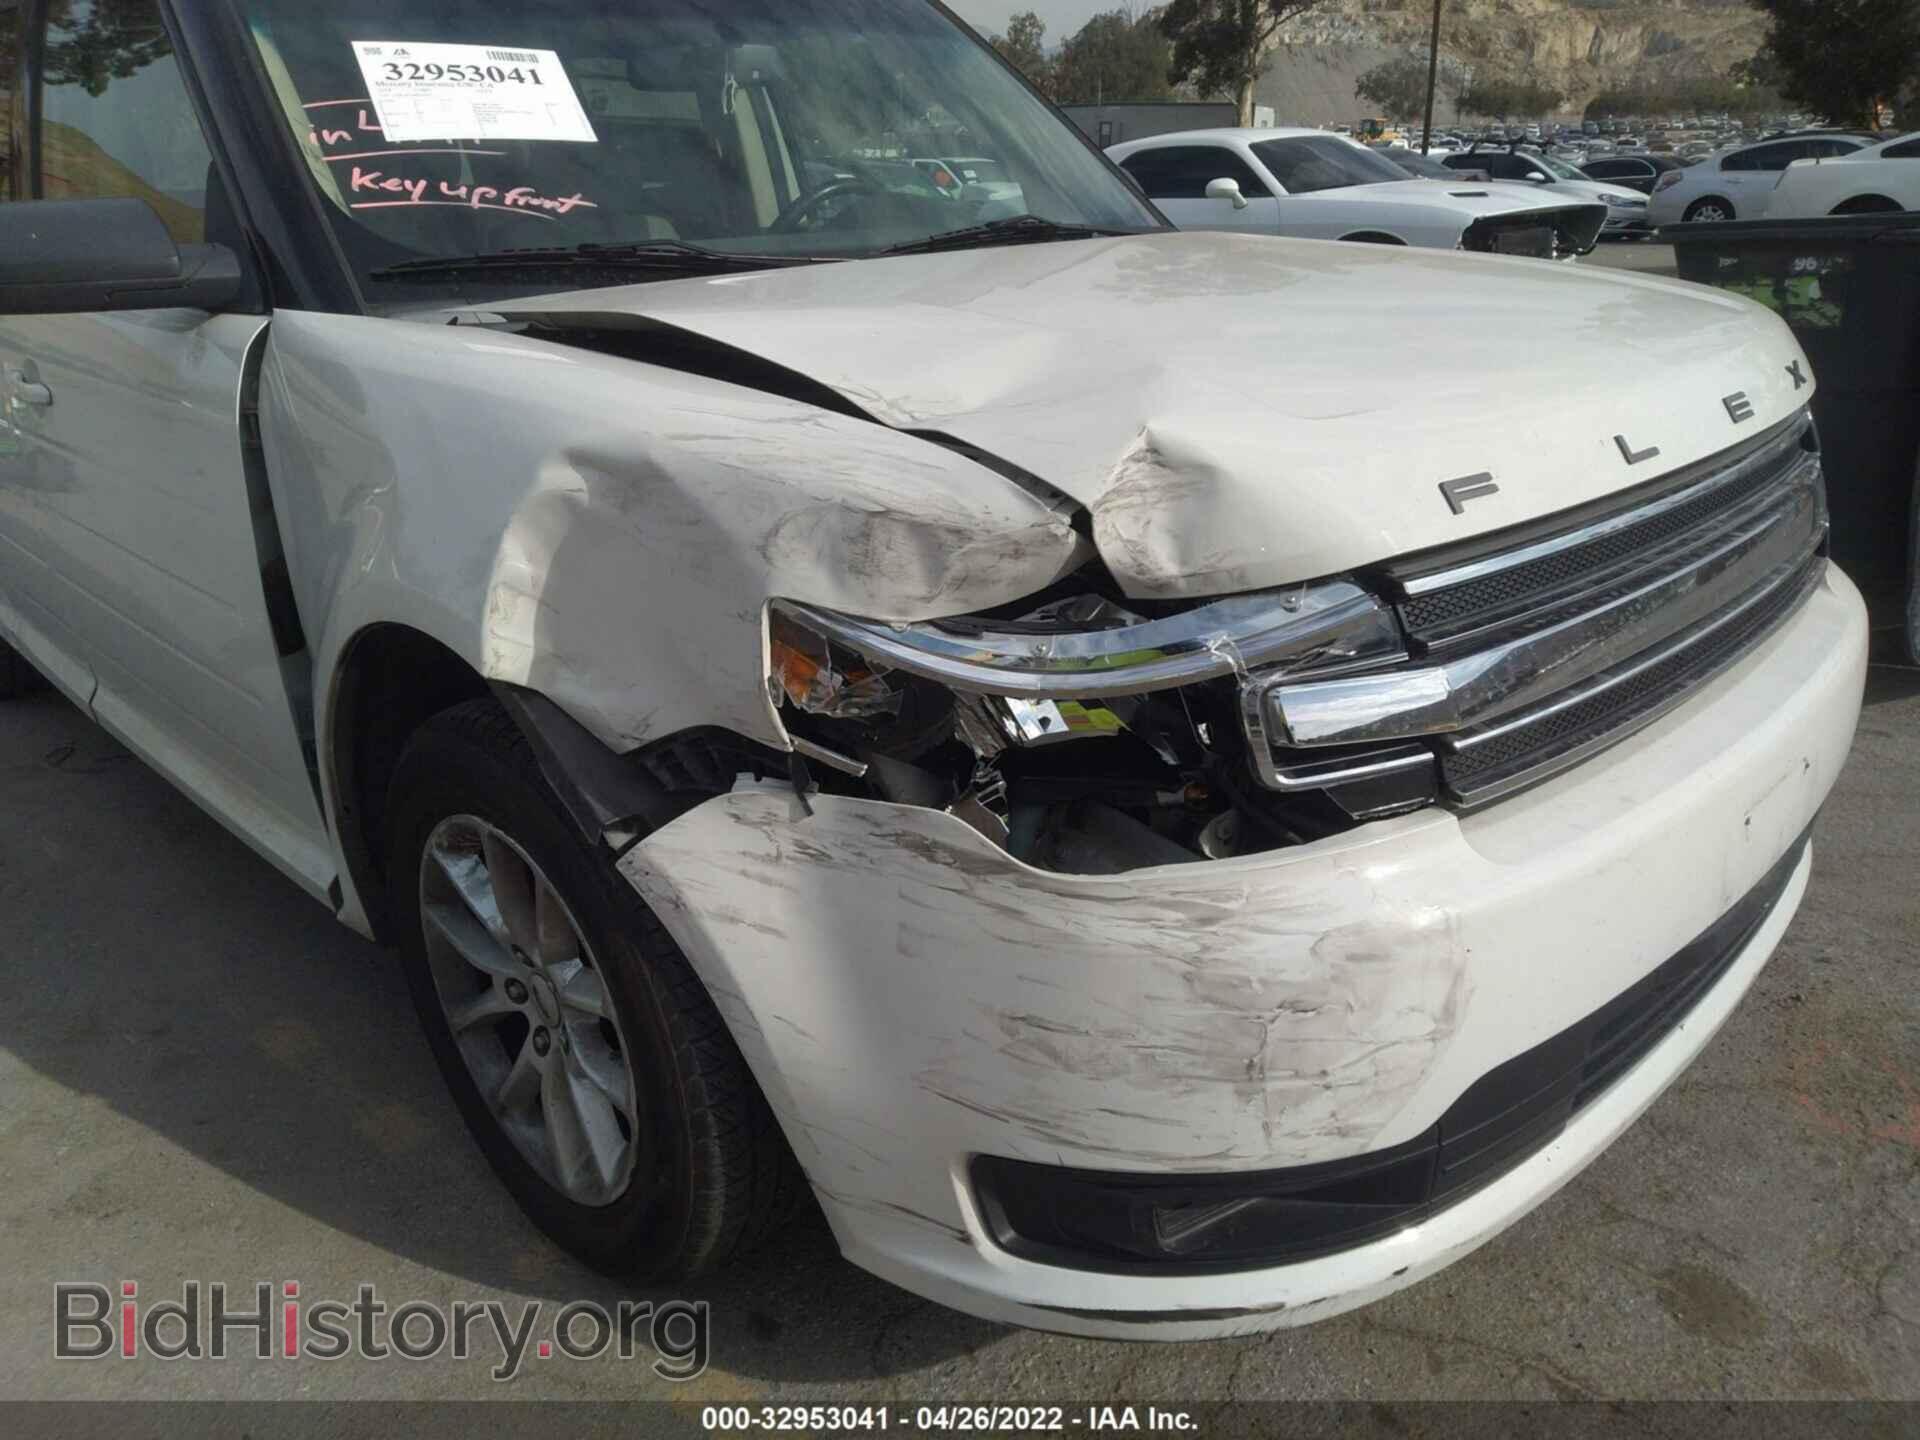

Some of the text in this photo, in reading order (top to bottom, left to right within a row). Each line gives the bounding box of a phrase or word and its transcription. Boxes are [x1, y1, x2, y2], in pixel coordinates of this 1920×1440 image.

[382, 62, 544, 86] 32953041
[309, 123, 353, 146] in
[351, 166, 427, 204] Key
[439, 180, 498, 210] up
